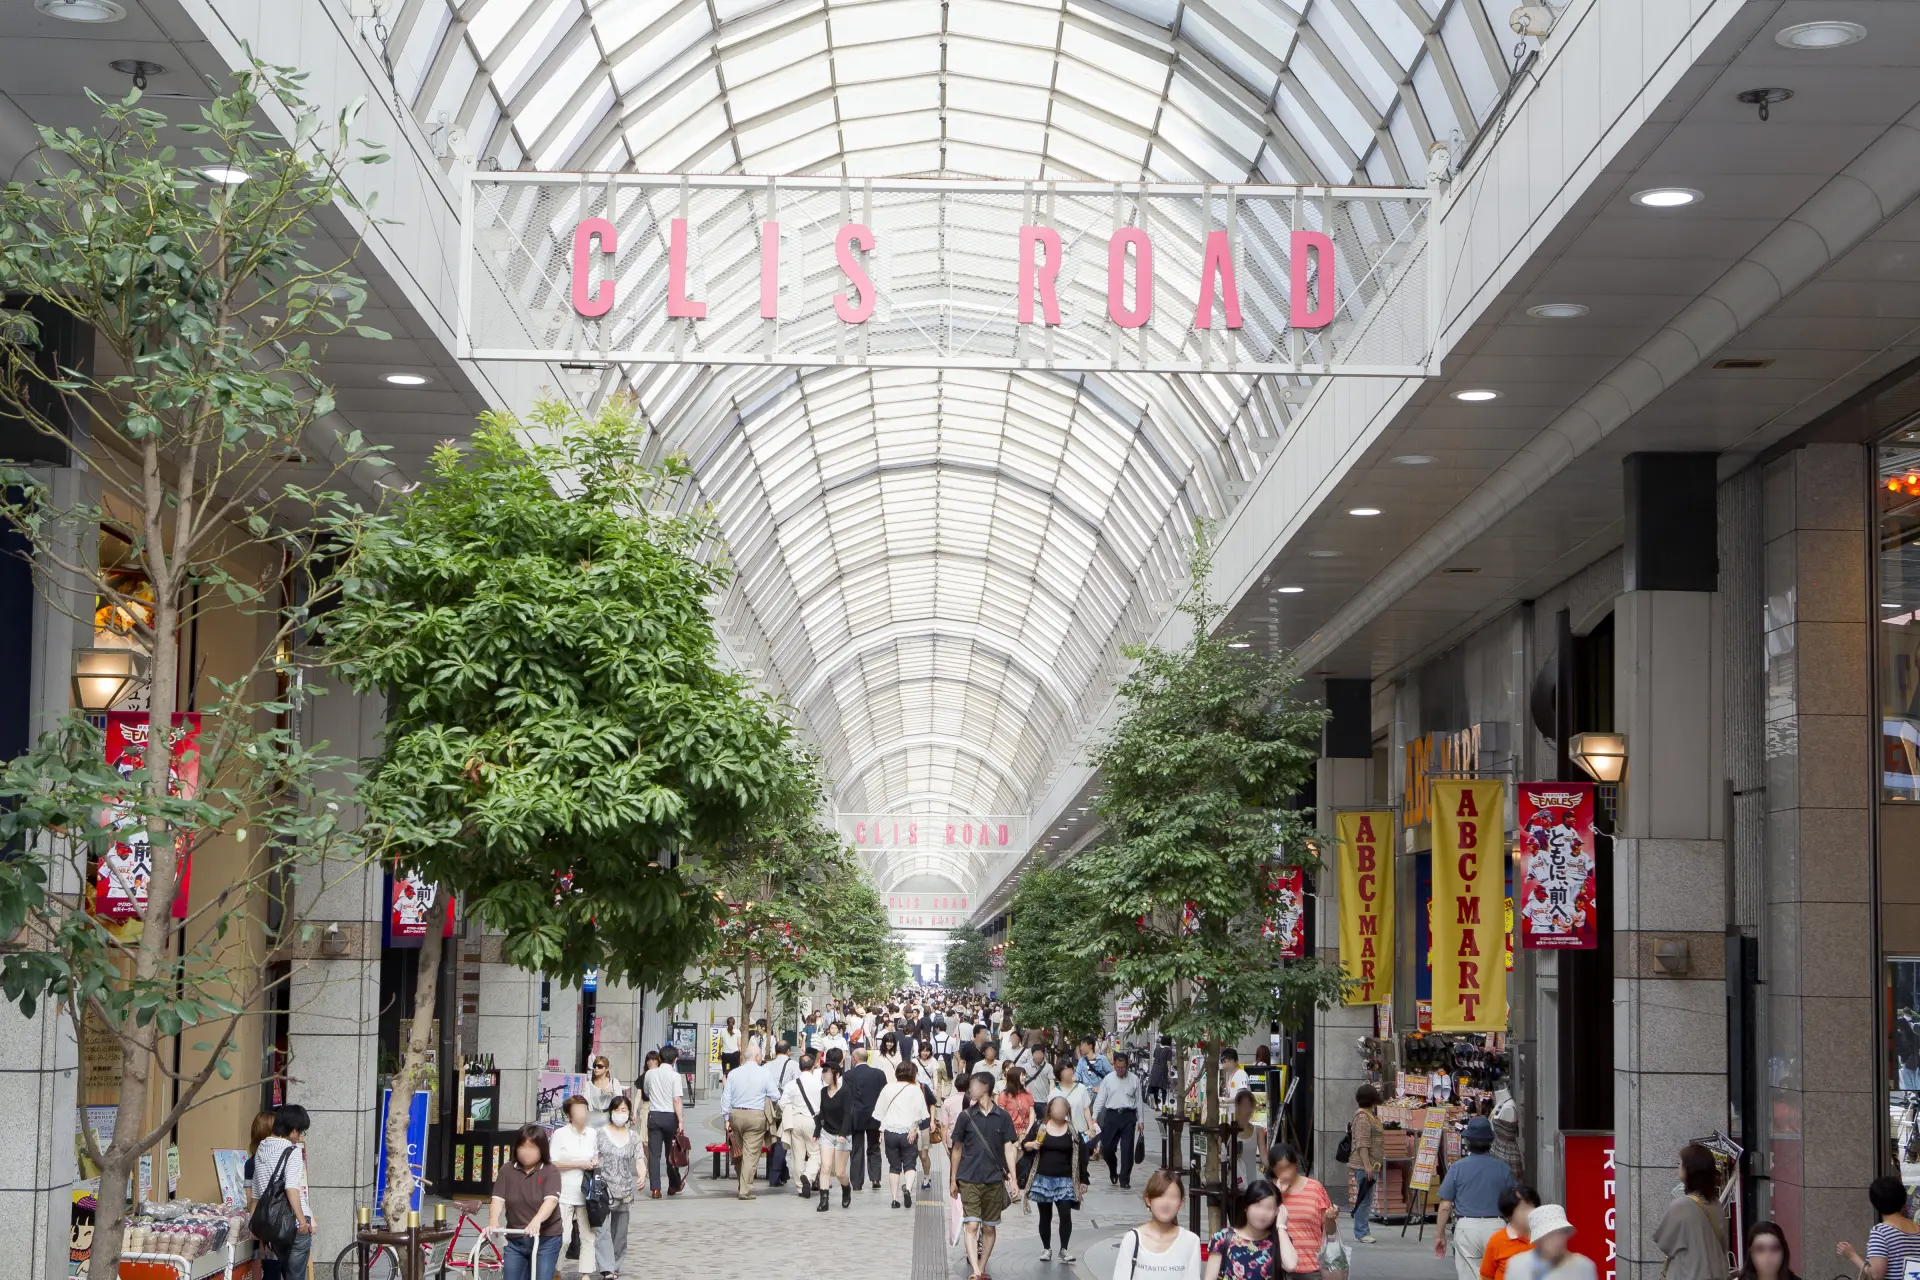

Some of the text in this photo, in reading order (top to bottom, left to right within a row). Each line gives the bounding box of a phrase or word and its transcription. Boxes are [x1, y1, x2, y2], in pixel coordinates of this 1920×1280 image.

[572, 216, 1335, 329] CLIS ROAD
[856, 821, 1009, 846] CLIS ROAD
[1539, 797, 1574, 807] EAGLES
[1355, 815, 1378, 1002] ABC-MART
[1456, 789, 1481, 1022] ABC-MART
[1548, 829, 1572, 923] ともに、前へ。
[711, 1028, 719, 1061] コンタクト
